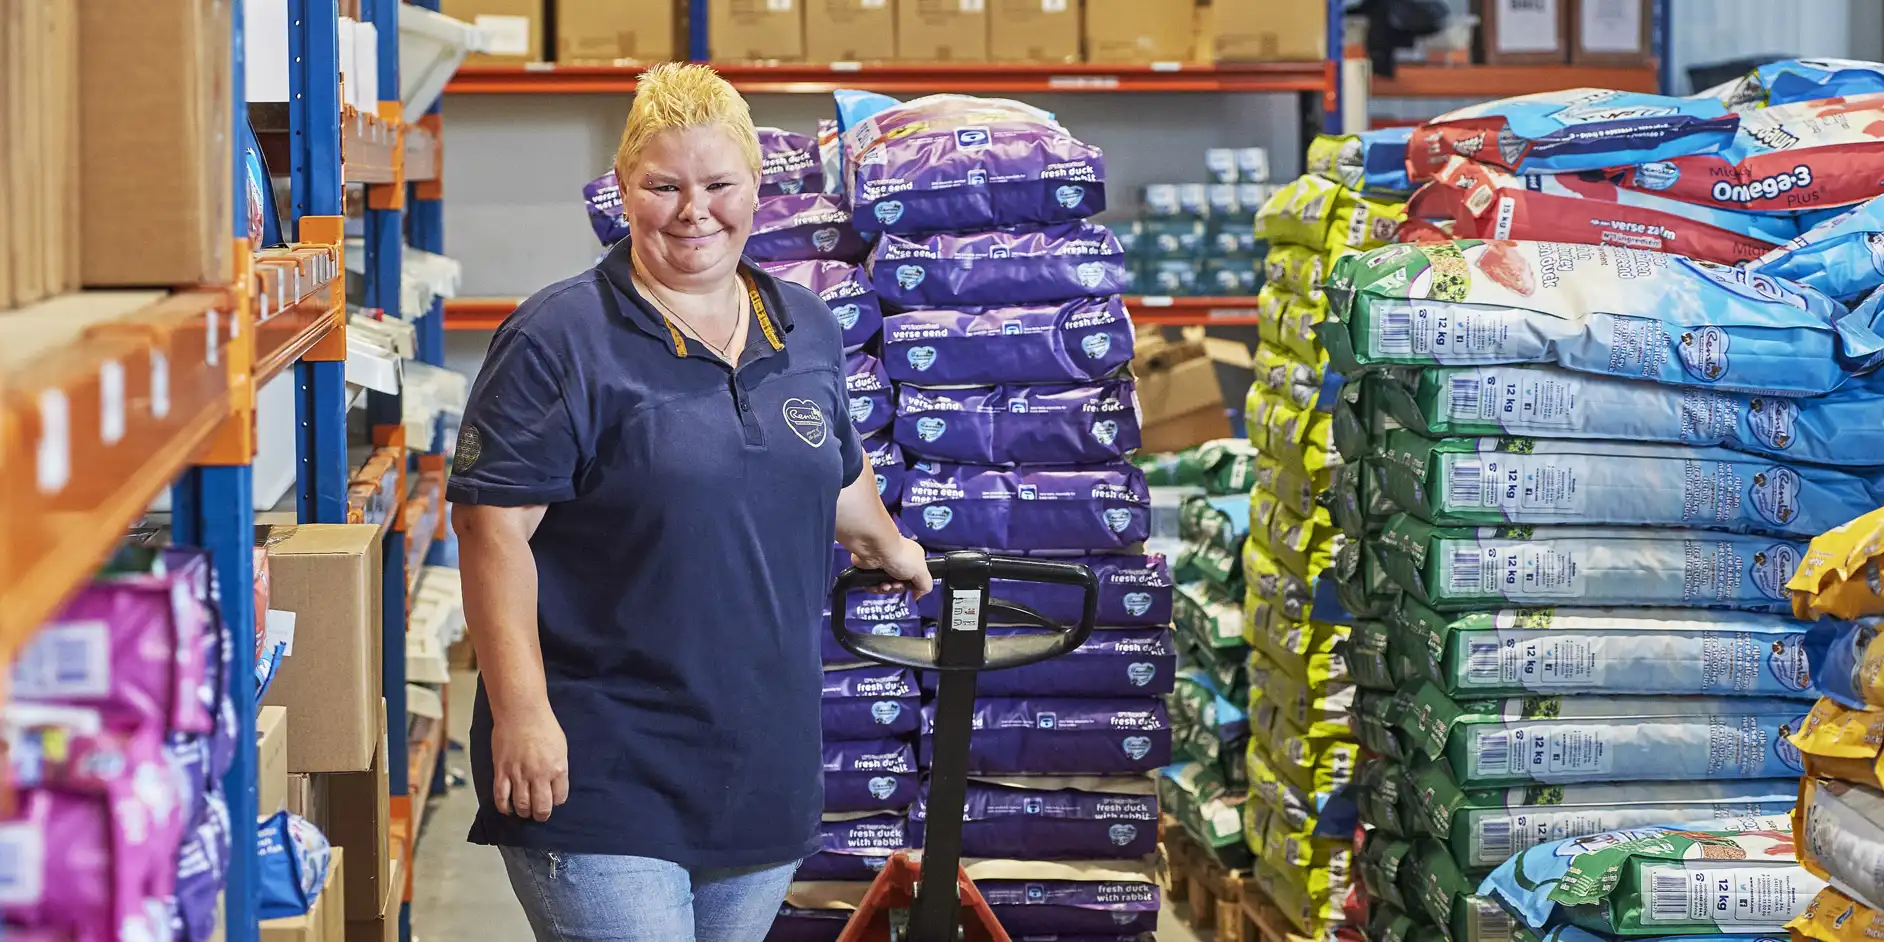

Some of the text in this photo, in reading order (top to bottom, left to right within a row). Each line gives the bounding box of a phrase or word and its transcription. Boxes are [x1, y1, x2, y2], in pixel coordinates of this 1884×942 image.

[1041, 168, 1066, 179] fresh
[1068, 166, 1093, 176] duck
[888, 182, 913, 192] eend
[1611, 221, 1645, 233] verse
[914, 250, 936, 259] eend
[1065, 318, 1091, 329] fresh
[923, 329, 948, 337] eend
[1436, 317, 1447, 346] 12 kg
[1612, 330, 1620, 352] fresh
[1629, 330, 1637, 347] rich
[1662, 331, 1671, 346] rijk
[1618, 341, 1629, 367] turkey
[1642, 333, 1653, 376] verse eend
[1651, 341, 1662, 375] kalkoen
[1504, 384, 1516, 412] 12 kg
[934, 402, 960, 410] eend
[1506, 469, 1518, 498] 12 kg
[911, 487, 964, 497] verse eend
[1092, 489, 1117, 498] fresh
[1733, 477, 1742, 508] rijk aan
[1506, 555, 1517, 584] 12 kg
[1735, 556, 1743, 571] rijk
[1111, 575, 1136, 583] fresh
[856, 602, 905, 615] fresh duk
[1115, 643, 1140, 651] fresh
[1524, 646, 1536, 674] 12 kg
[857, 682, 883, 692] fresh
[1111, 717, 1136, 726] fresh
[1533, 736, 1544, 765] 12 kg
[854, 756, 904, 769] fresh duk
[1096, 803, 1148, 812] fresh duck
[849, 829, 901, 838] fresh duck
[1538, 823, 1546, 834] 12
[848, 838, 903, 846] with rabbit
[1098, 885, 1122, 893] fresh
[1716, 878, 1729, 911] 12 kg
